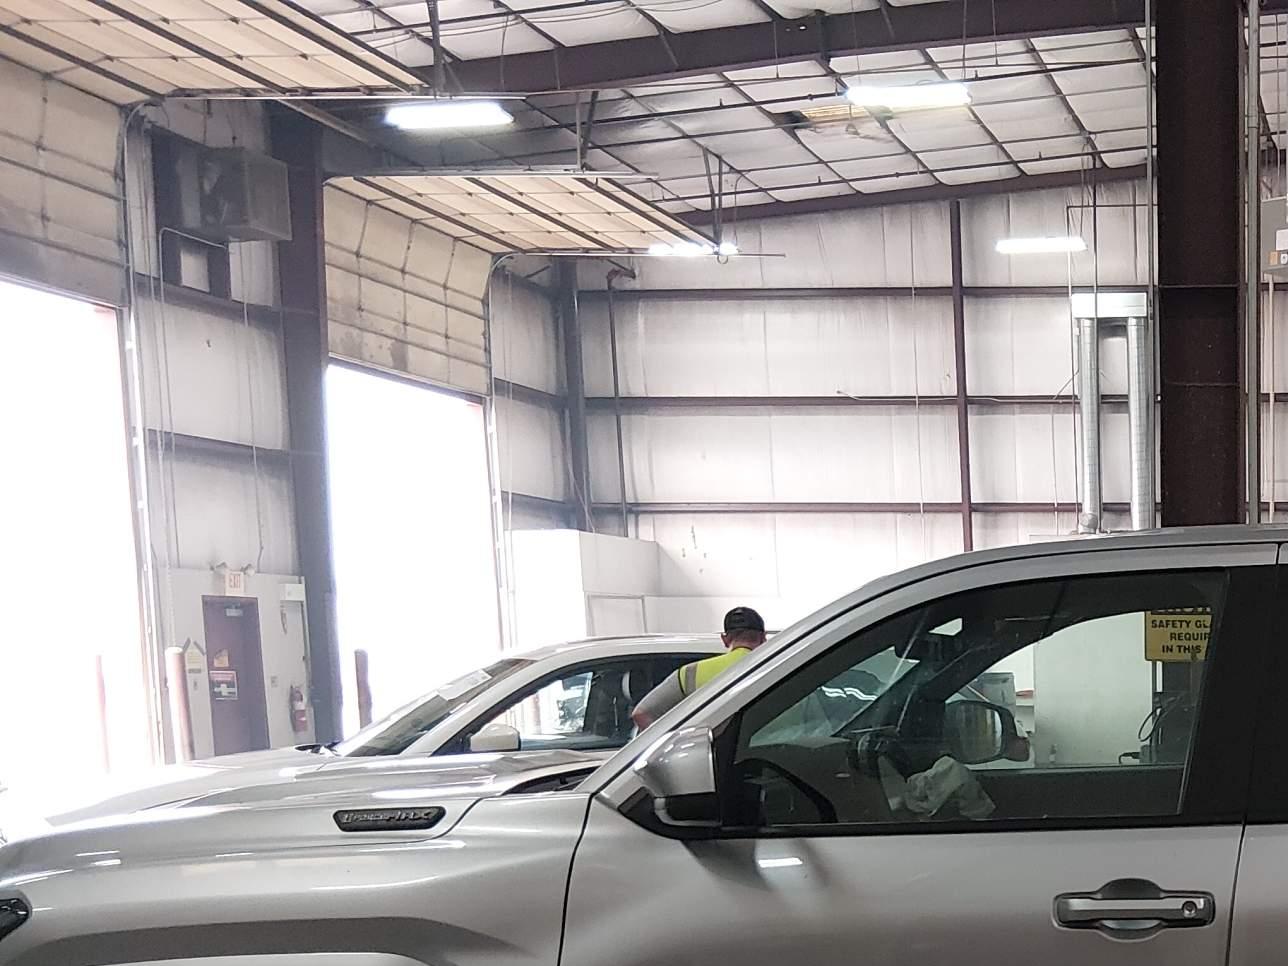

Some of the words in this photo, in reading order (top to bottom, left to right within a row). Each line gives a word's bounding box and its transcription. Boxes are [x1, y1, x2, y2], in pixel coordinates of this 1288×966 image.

[1151, 620, 1191, 628] SAFETY
[1195, 620, 1212, 628] GL
[1162, 645, 1173, 653] IN
[1176, 645, 1202, 653] THIS
